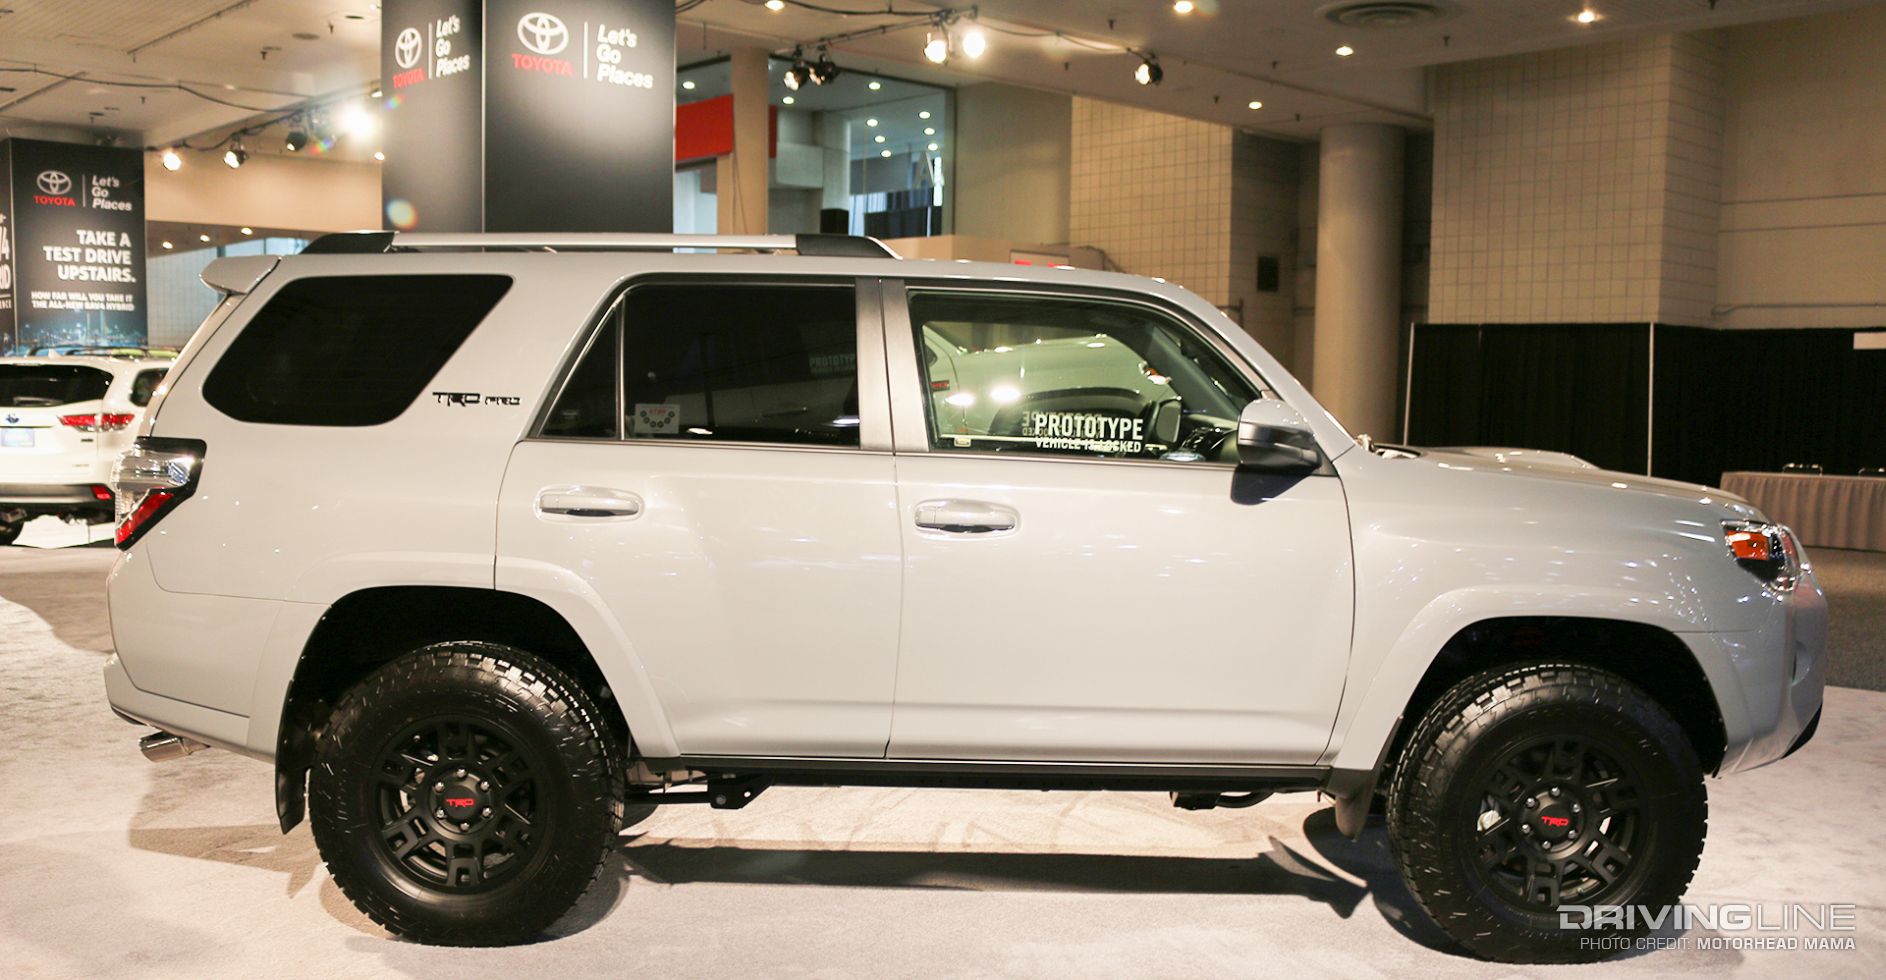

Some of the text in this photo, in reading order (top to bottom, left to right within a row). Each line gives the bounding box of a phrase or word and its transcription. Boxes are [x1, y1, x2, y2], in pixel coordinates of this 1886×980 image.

[436, 15, 460, 38] Let's
[597, 24, 637, 48] Let's
[435, 38, 451, 57] Go
[596, 44, 621, 64] Go
[436, 54, 470, 78] Places
[512, 53, 573, 77] TOYOTA
[392, 68, 425, 88] TOYOTA
[597, 63, 653, 89] Places
[92, 175, 120, 188] Let's
[33, 195, 76, 207] TOYOTA
[91, 187, 109, 198] Go
[92, 198, 132, 211] Places
[76, 229, 131, 247] TAKE A
[43, 246, 132, 265] TEST DRIVE
[58, 265, 136, 283] UPSTAIRS.
[432, 392, 520, 407] TRD PRO
[1035, 414, 1143, 440] PROTOTYPE
[1036, 436, 1081, 450] VEHICLE
[446, 798, 474, 807] TRD
[1541, 815, 1569, 827] TRD
